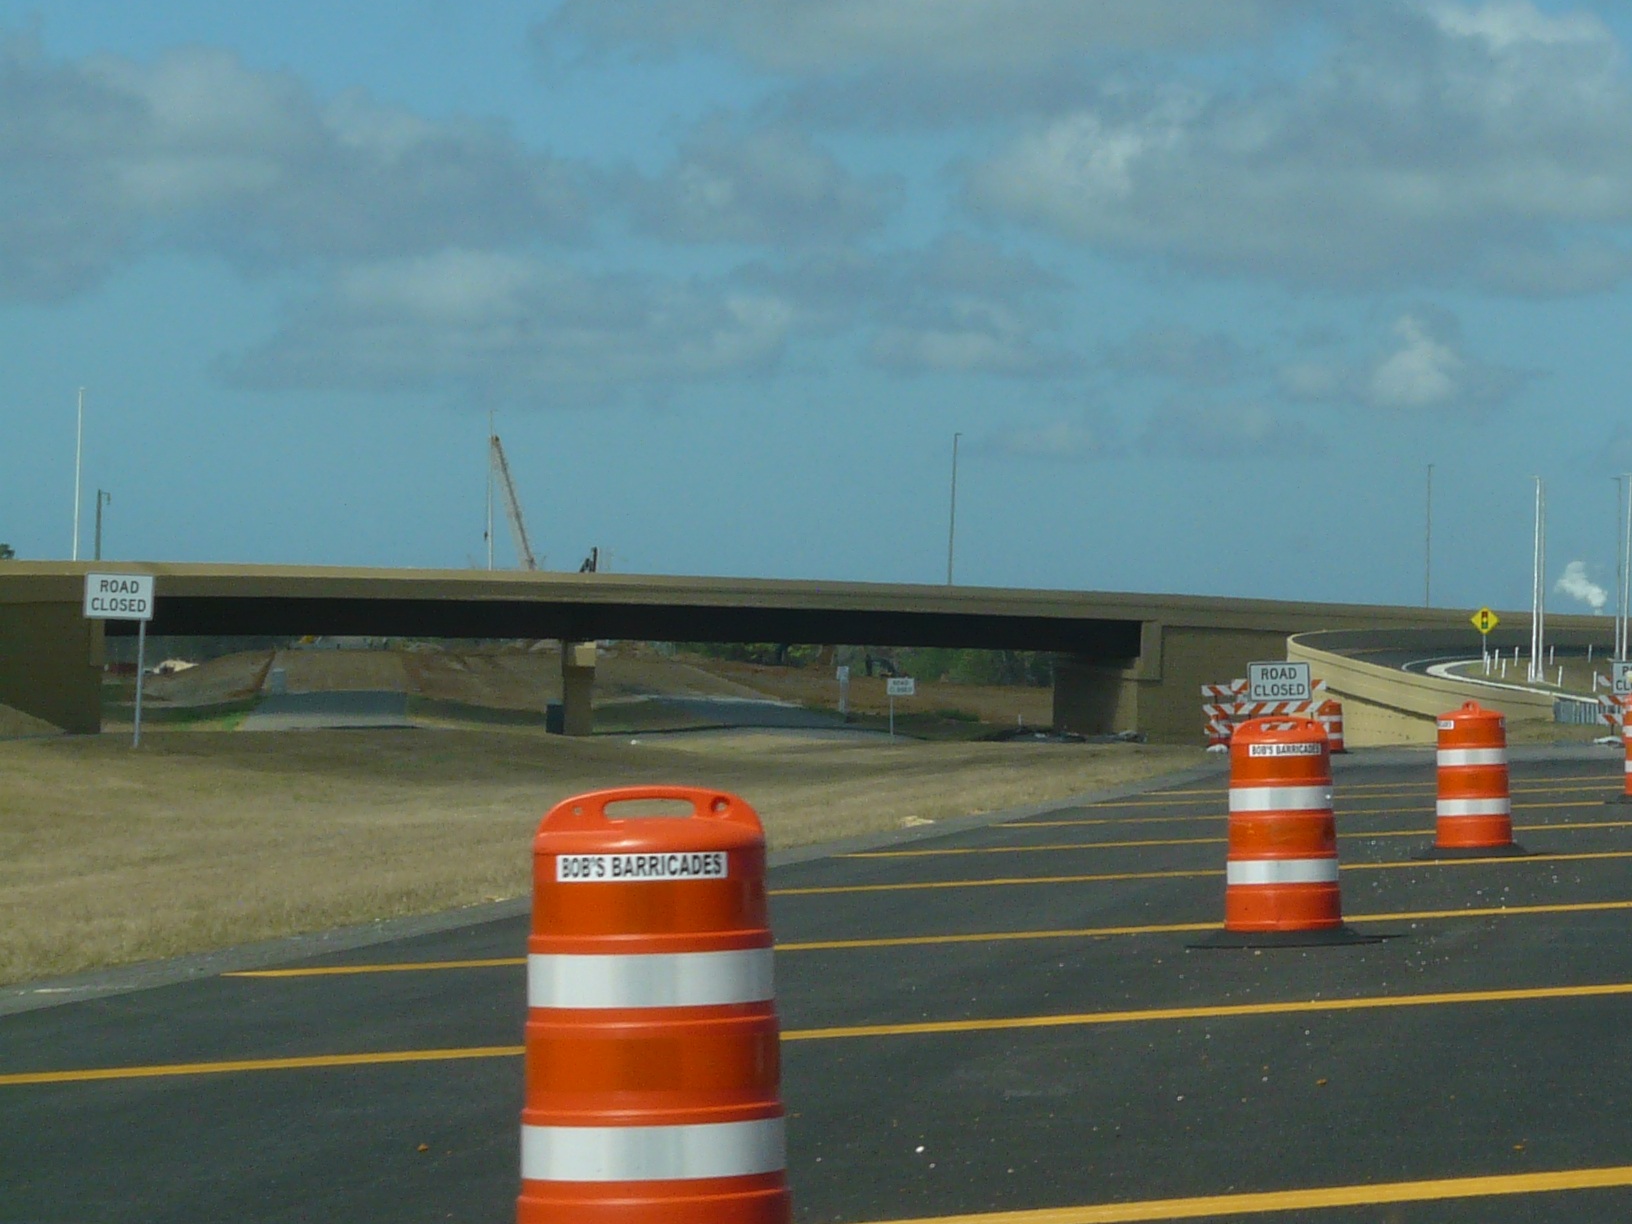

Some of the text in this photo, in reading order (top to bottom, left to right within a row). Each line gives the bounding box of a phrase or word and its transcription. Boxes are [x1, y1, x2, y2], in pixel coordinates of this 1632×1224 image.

[100, 579, 139, 594] ROAD
[91, 597, 147, 613] CLOSED
[1261, 667, 1298, 680] ROAD
[1254, 683, 1305, 697] CLOSED
[562, 853, 723, 878] BOB'S BARRICADES
